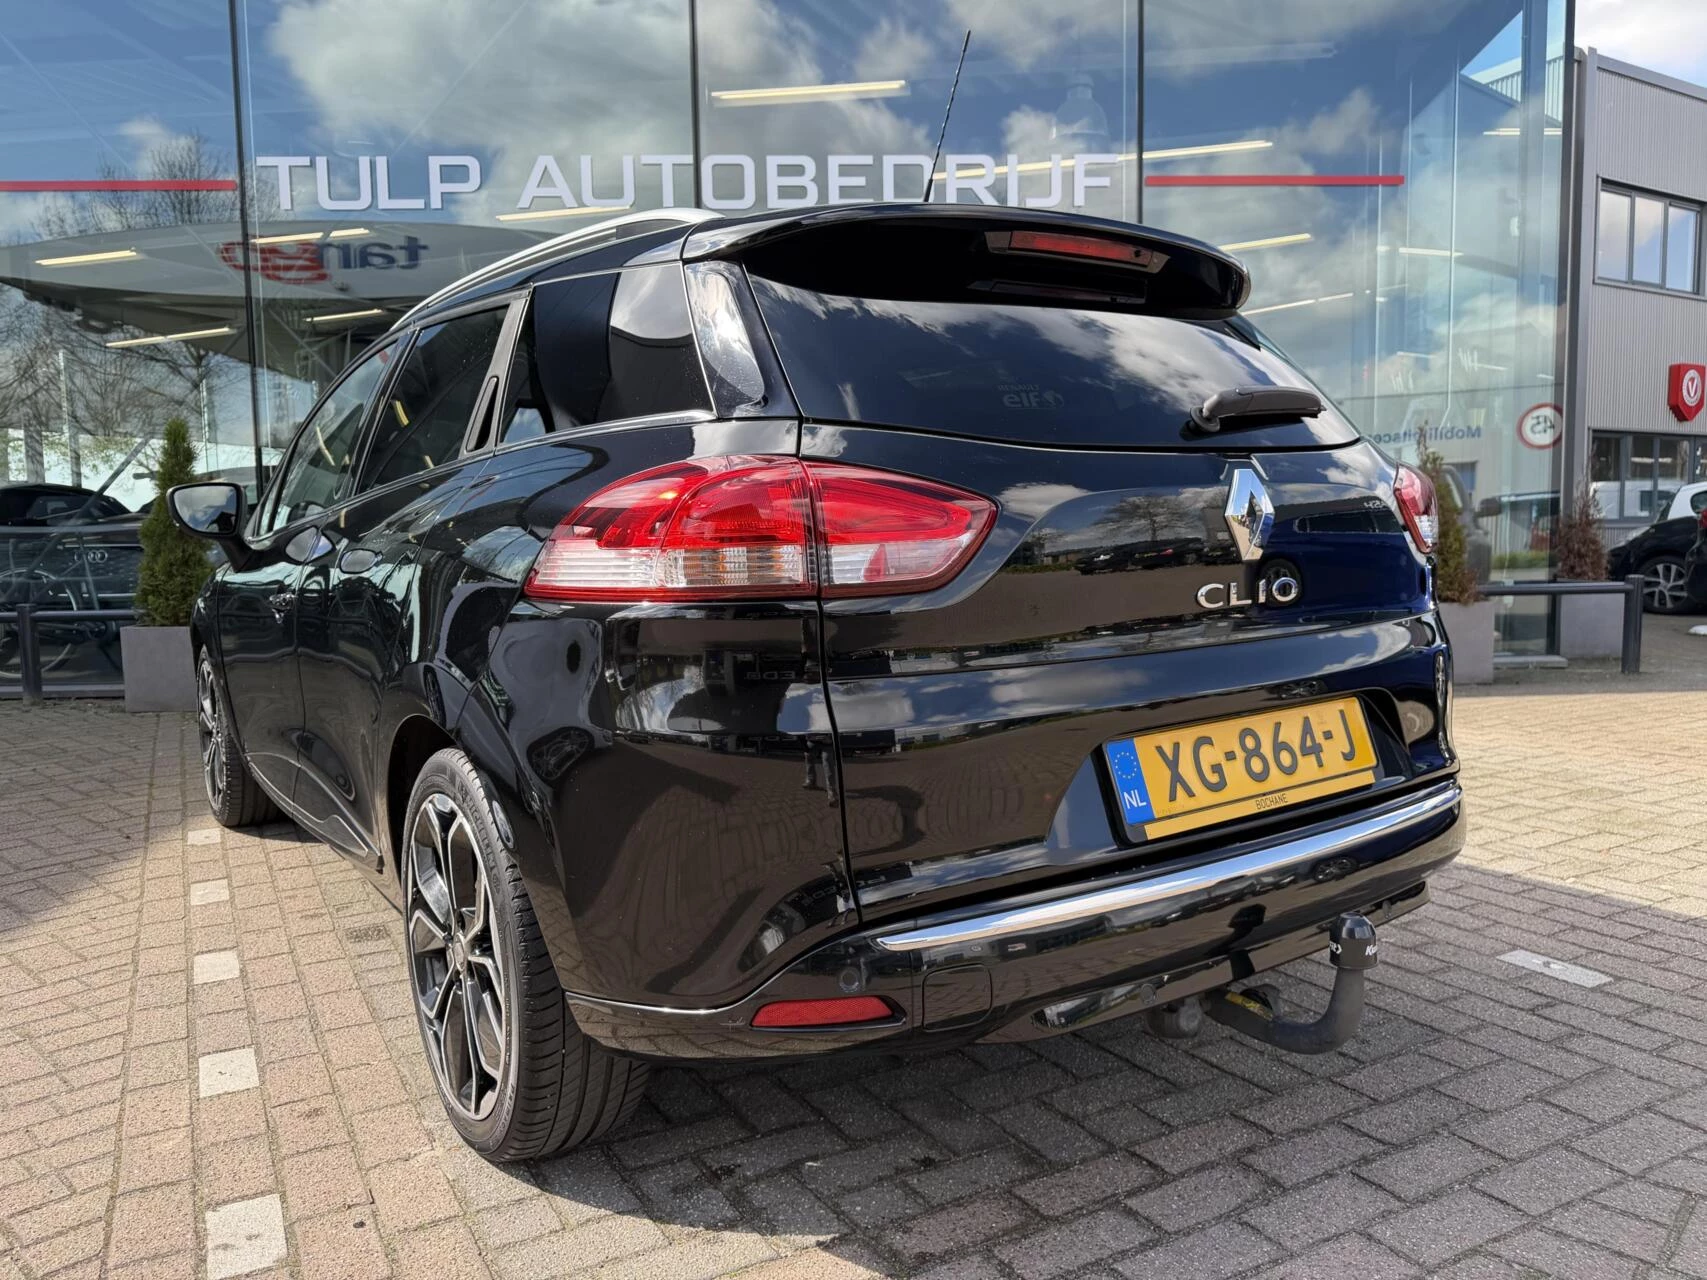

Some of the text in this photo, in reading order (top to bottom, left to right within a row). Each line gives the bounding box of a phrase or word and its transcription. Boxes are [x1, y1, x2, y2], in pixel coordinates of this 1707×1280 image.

[256, 154, 1119, 210] TULP AUTOBEDRIJF
[1196, 577, 1298, 609] CLIO
[1155, 708, 1357, 802] XG-864-J
[1123, 790, 1147, 810] NL
[1256, 793, 1289, 810] BOCHANE
